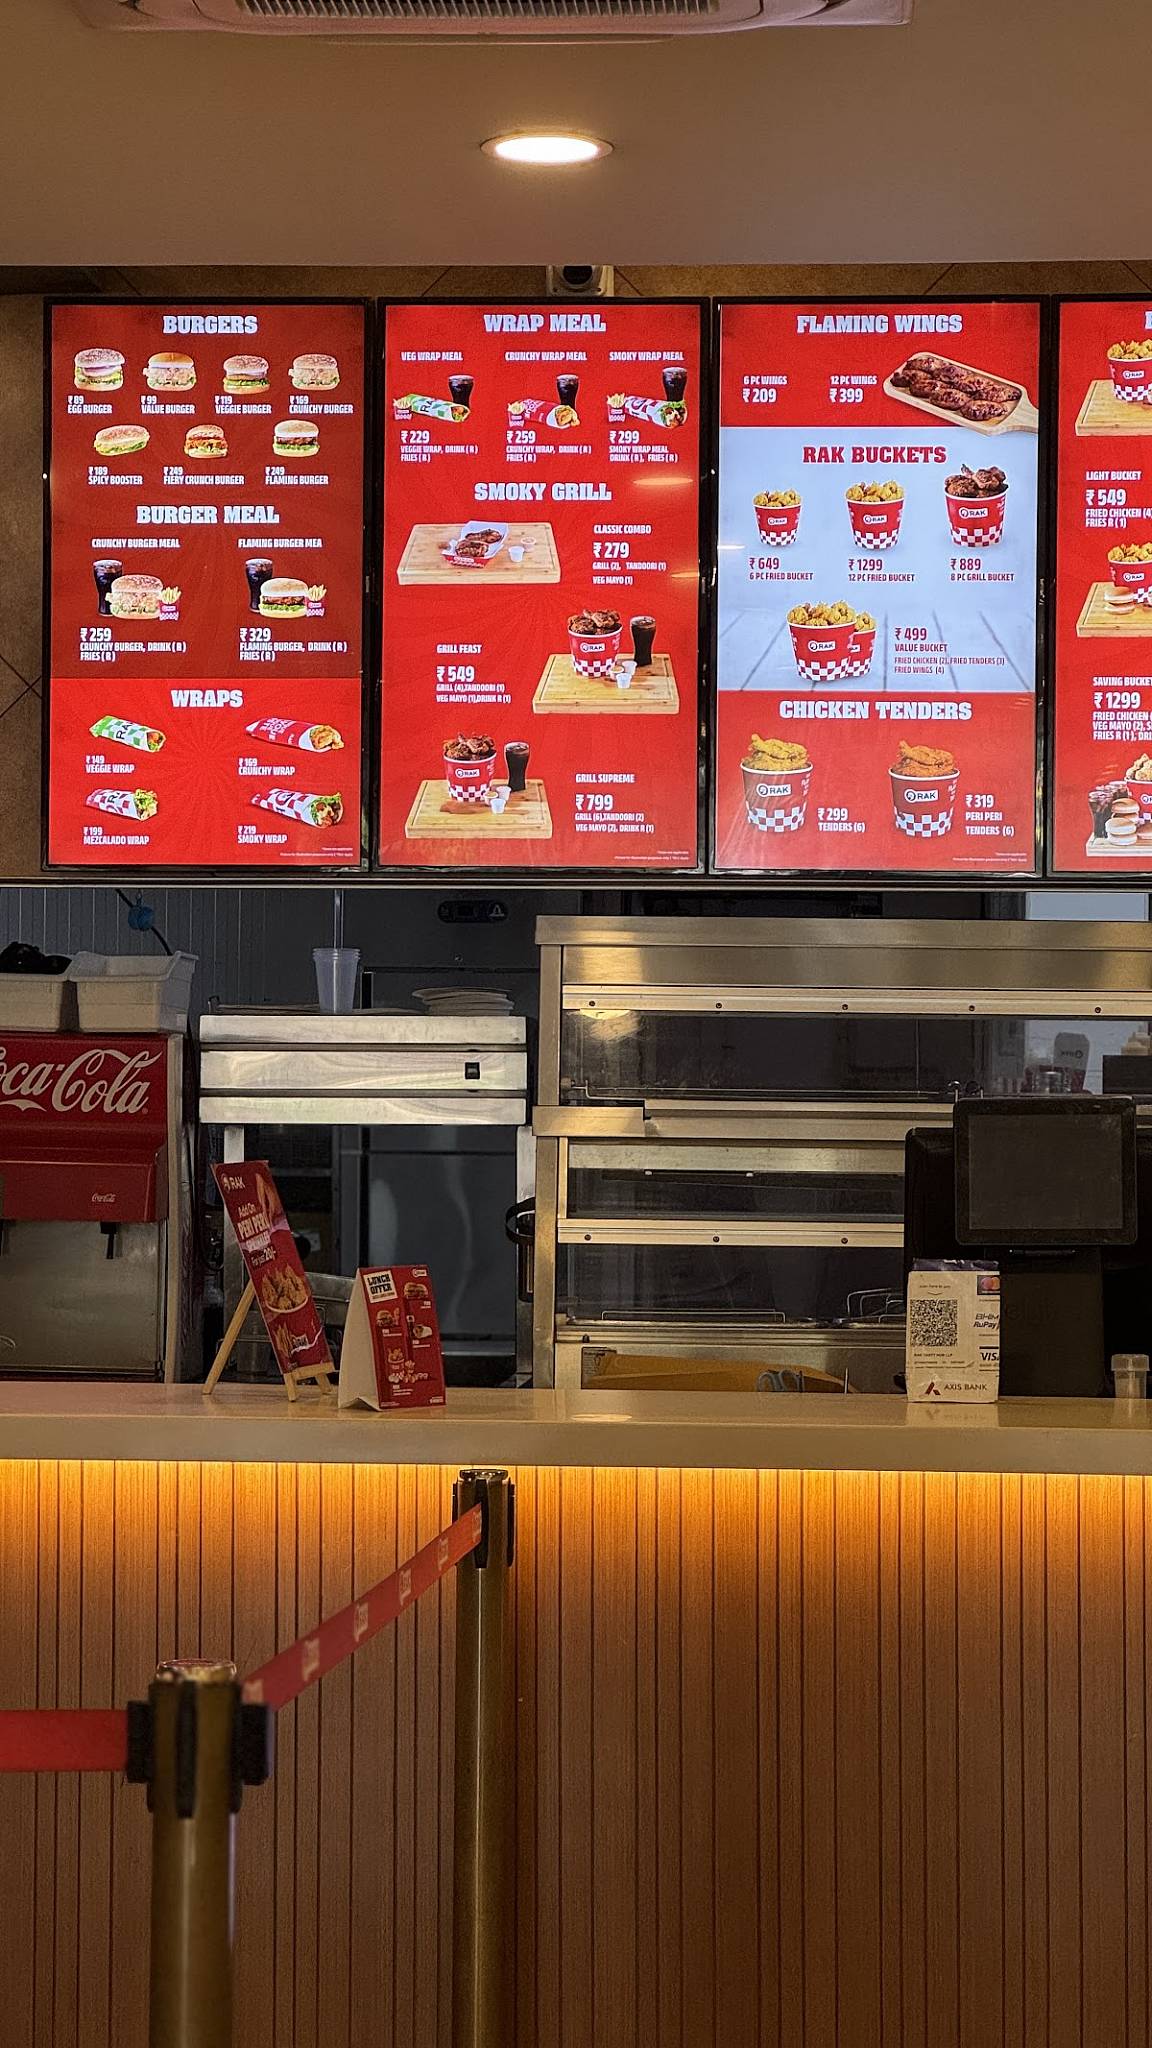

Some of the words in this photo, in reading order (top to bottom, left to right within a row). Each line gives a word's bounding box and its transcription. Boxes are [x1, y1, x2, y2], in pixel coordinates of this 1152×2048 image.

[163, 315, 258, 334] BURGERS
[483, 314, 544, 332] WRAP
[550, 314, 606, 332] MEAL
[797, 315, 888, 334] FLAMING
[895, 315, 962, 334] WINGS
[401, 351, 416, 361] VEG
[417, 351, 441, 361] WRAP
[442, 351, 463, 361] MEAL
[505, 351, 538, 361] CRUNCHY
[539, 351, 564, 361] WRAP
[566, 351, 587, 361] MEAL
[609, 351, 635, 361] SMOKY
[636, 351, 661, 361] WRAP
[662, 351, 684, 361] MEAL
[744, 376, 750, 385] 6
[751, 376, 760, 385] PC
[761, 376, 787, 385] WINGS
[831, 376, 839, 385] 12
[840, 376, 850, 385] PC
[851, 376, 877, 385] WINGS
[68, 404, 82, 414] EGG
[83, 404, 112, 414] BURGER
[141, 404, 164, 414] VALUE
[165, 404, 195, 414] BURGER
[215, 404, 241, 414] VEGGIE
[242, 404, 272, 414] BURGER
[289, 404, 322, 414] CRUNCHY
[324, 404, 353, 414] BURGER
[803, 447, 844, 464] RAK
[852, 447, 947, 464] BUCKETS
[88, 475, 108, 485] SPICY
[110, 475, 143, 485] BOOSTER
[163, 475, 183, 485] FIERY
[184, 475, 213, 485] CRUNCH
[215, 475, 244, 485] BURGER
[266, 475, 298, 485] FLAMING
[299, 475, 328, 485] BURGER
[1086, 470, 1110, 481] LIGHT
[1111, 470, 1141, 481] BUCKET
[474, 482, 546, 501] SMOKY
[552, 482, 612, 501] GRILL
[136, 505, 218, 524] BURGER
[224, 505, 280, 524] MEAL
[970, 508, 987, 517] RAK
[1086, 508, 1108, 518] FRIED
[1109, 508, 1142, 518] CHICKEN
[594, 525, 622, 534] CLASSIC
[624, 525, 651, 534] COMBO
[92, 539, 126, 548] CRUNCHY
[128, 539, 158, 548] BURGER
[159, 539, 180, 548] MEAL
[238, 539, 273, 548] FLAMING
[274, 539, 304, 548] BURGER
[305, 539, 322, 548] MEA
[750, 572, 754, 581] 6
[756, 572, 765, 581] PC
[766, 572, 786, 581] FRIED
[787, 572, 813, 581] BUCKET
[849, 573, 856, 582] 12
[857, 573, 866, 582] PC
[867, 573, 887, 582] FRIED
[888, 573, 915, 582] BUCKET
[951, 573, 955, 582] 8
[957, 573, 966, 582] PC
[967, 573, 987, 582] GRILL
[988, 573, 1015, 582] BUCKET
[437, 644, 458, 654] GRILL
[459, 644, 481, 654] FEAST
[589, 643, 603, 652] RAK
[818, 642, 834, 650] RAK
[895, 643, 917, 653] VALUE
[919, 643, 947, 653] BUCKET
[895, 666, 911, 675] FRIED
[912, 666, 933, 675] WINGS
[1093, 677, 1123, 687] SAVING
[171, 690, 243, 708] WRAPS
[779, 701, 869, 720] CHICKEN
[875, 701, 972, 720] TENDERS
[1093, 711, 1115, 721] FRIED
[1116, 711, 1149, 721] CHICKEN
[1093, 721, 1108, 731] VEG
[1110, 721, 1131, 731] MAYO
[86, 764, 111, 773] VEGGIE
[113, 764, 134, 773] WRAP
[239, 766, 272, 775] CRUNCHY
[273, 766, 295, 775] WRAP
[576, 773, 597, 783] GRILL
[598, 773, 635, 783] SUPREME
[769, 785, 789, 794] RAK
[917, 791, 936, 799] RAK
[966, 811, 983, 821] PERI
[985, 811, 1002, 821] PERI
[818, 822, 852, 832] TENDERS
[966, 826, 999, 836] TENDERS
[83, 836, 126, 845] MEZCALADO
[127, 836, 149, 845] WRAP
[238, 834, 264, 844] SMOKY
[265, 834, 287, 844] WRAP
[0, 1047, 162, 1115] ca-Cola
[230, 1176, 245, 1189] RAK
[237, 1220, 253, 1240] PERI
[253, 1214, 270, 1235] PERI
[367, 1274, 391, 1286] LUNCH
[371, 1283, 392, 1295] OFFER
[980, 1353, 999, 1361] VIS
